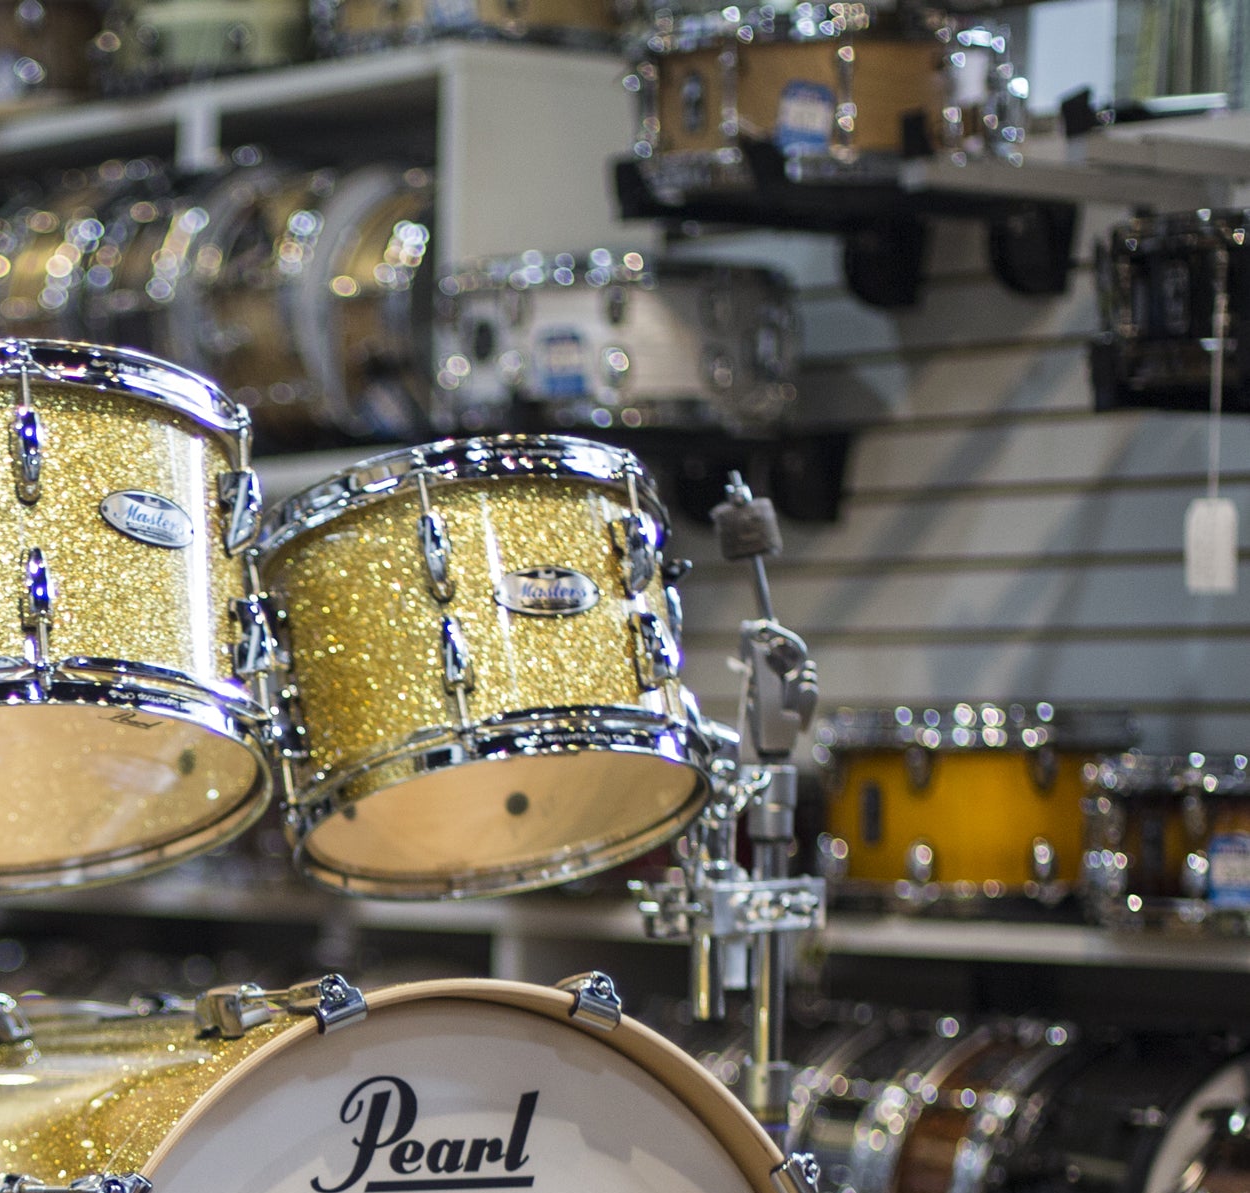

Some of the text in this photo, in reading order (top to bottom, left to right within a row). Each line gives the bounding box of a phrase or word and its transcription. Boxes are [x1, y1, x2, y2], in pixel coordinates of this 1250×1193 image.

[113, 503, 185, 536] Masters
[507, 580, 588, 600] Masters
[310, 1075, 539, 1193] Pearl
